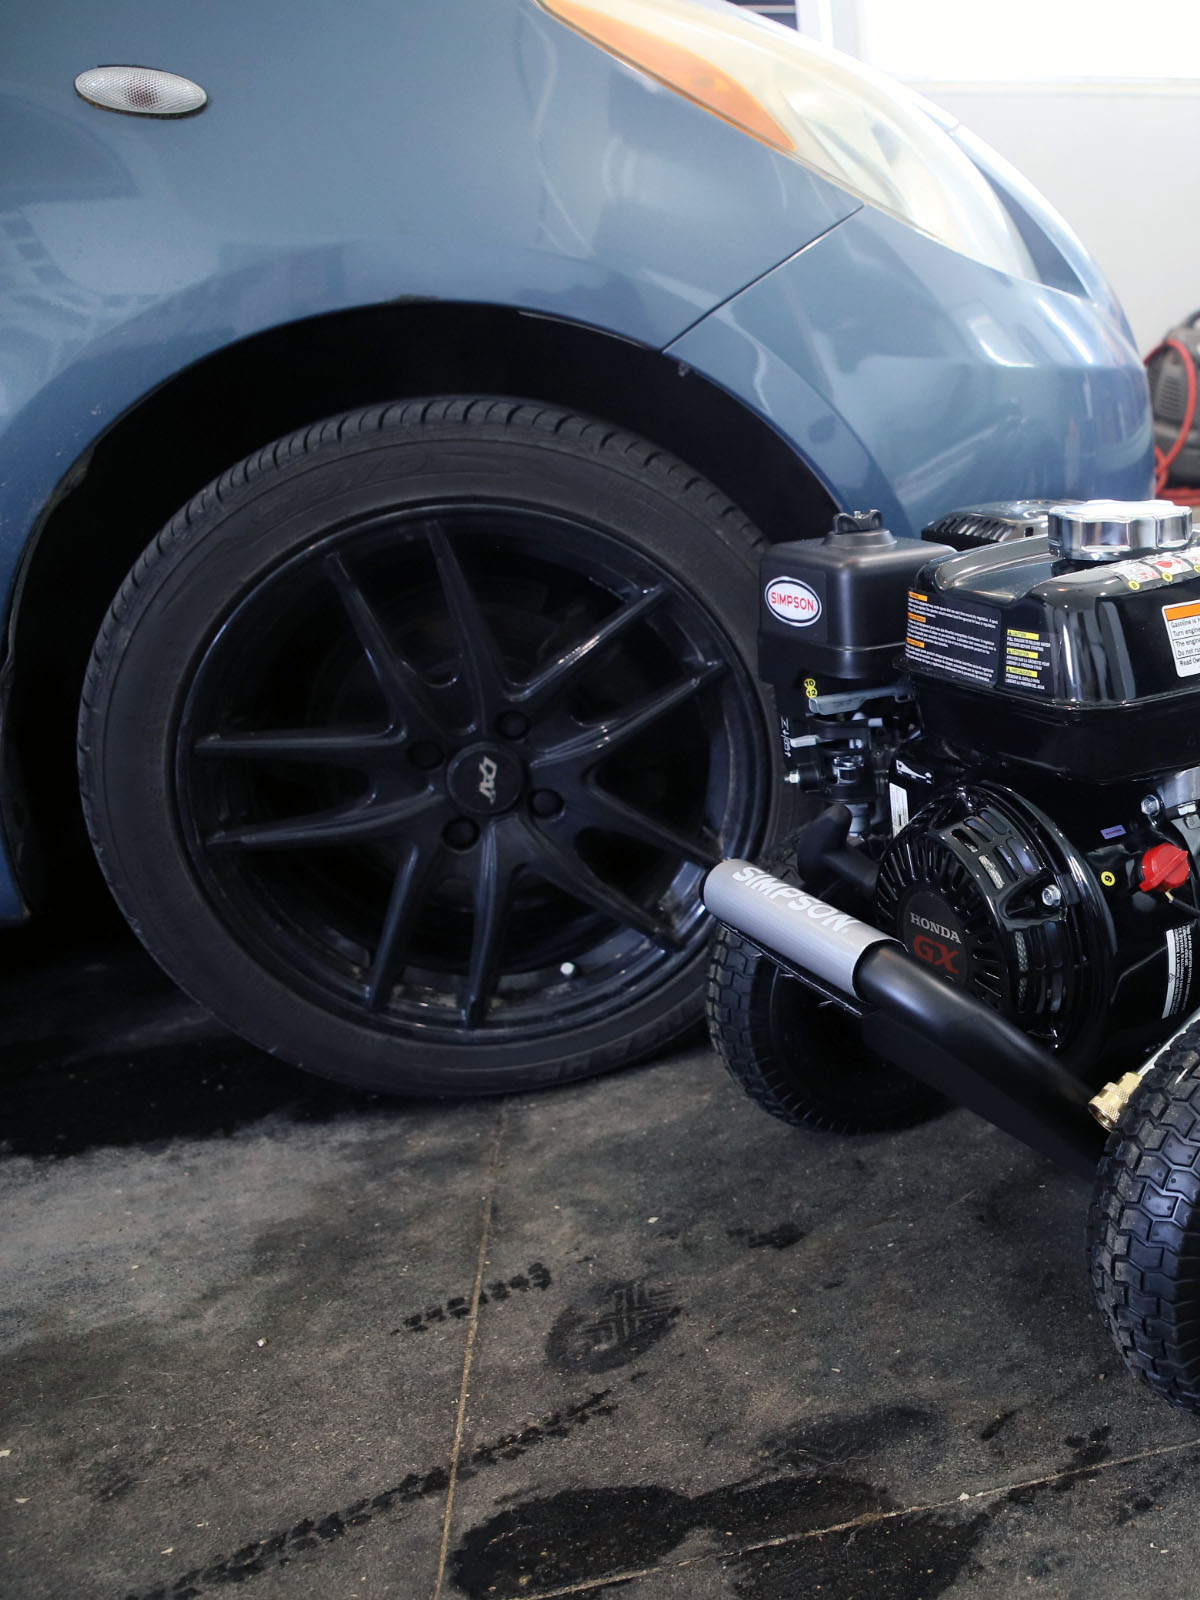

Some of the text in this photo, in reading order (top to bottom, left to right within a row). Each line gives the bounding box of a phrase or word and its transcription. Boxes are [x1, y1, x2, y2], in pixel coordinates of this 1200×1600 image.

[771, 591, 815, 612] SIMPSON
[1185, 627, 1200, 635] engine
[732, 866, 860, 932] SIMPSON
[910, 912, 962, 944] HONDA
[914, 935, 960, 974] GX
